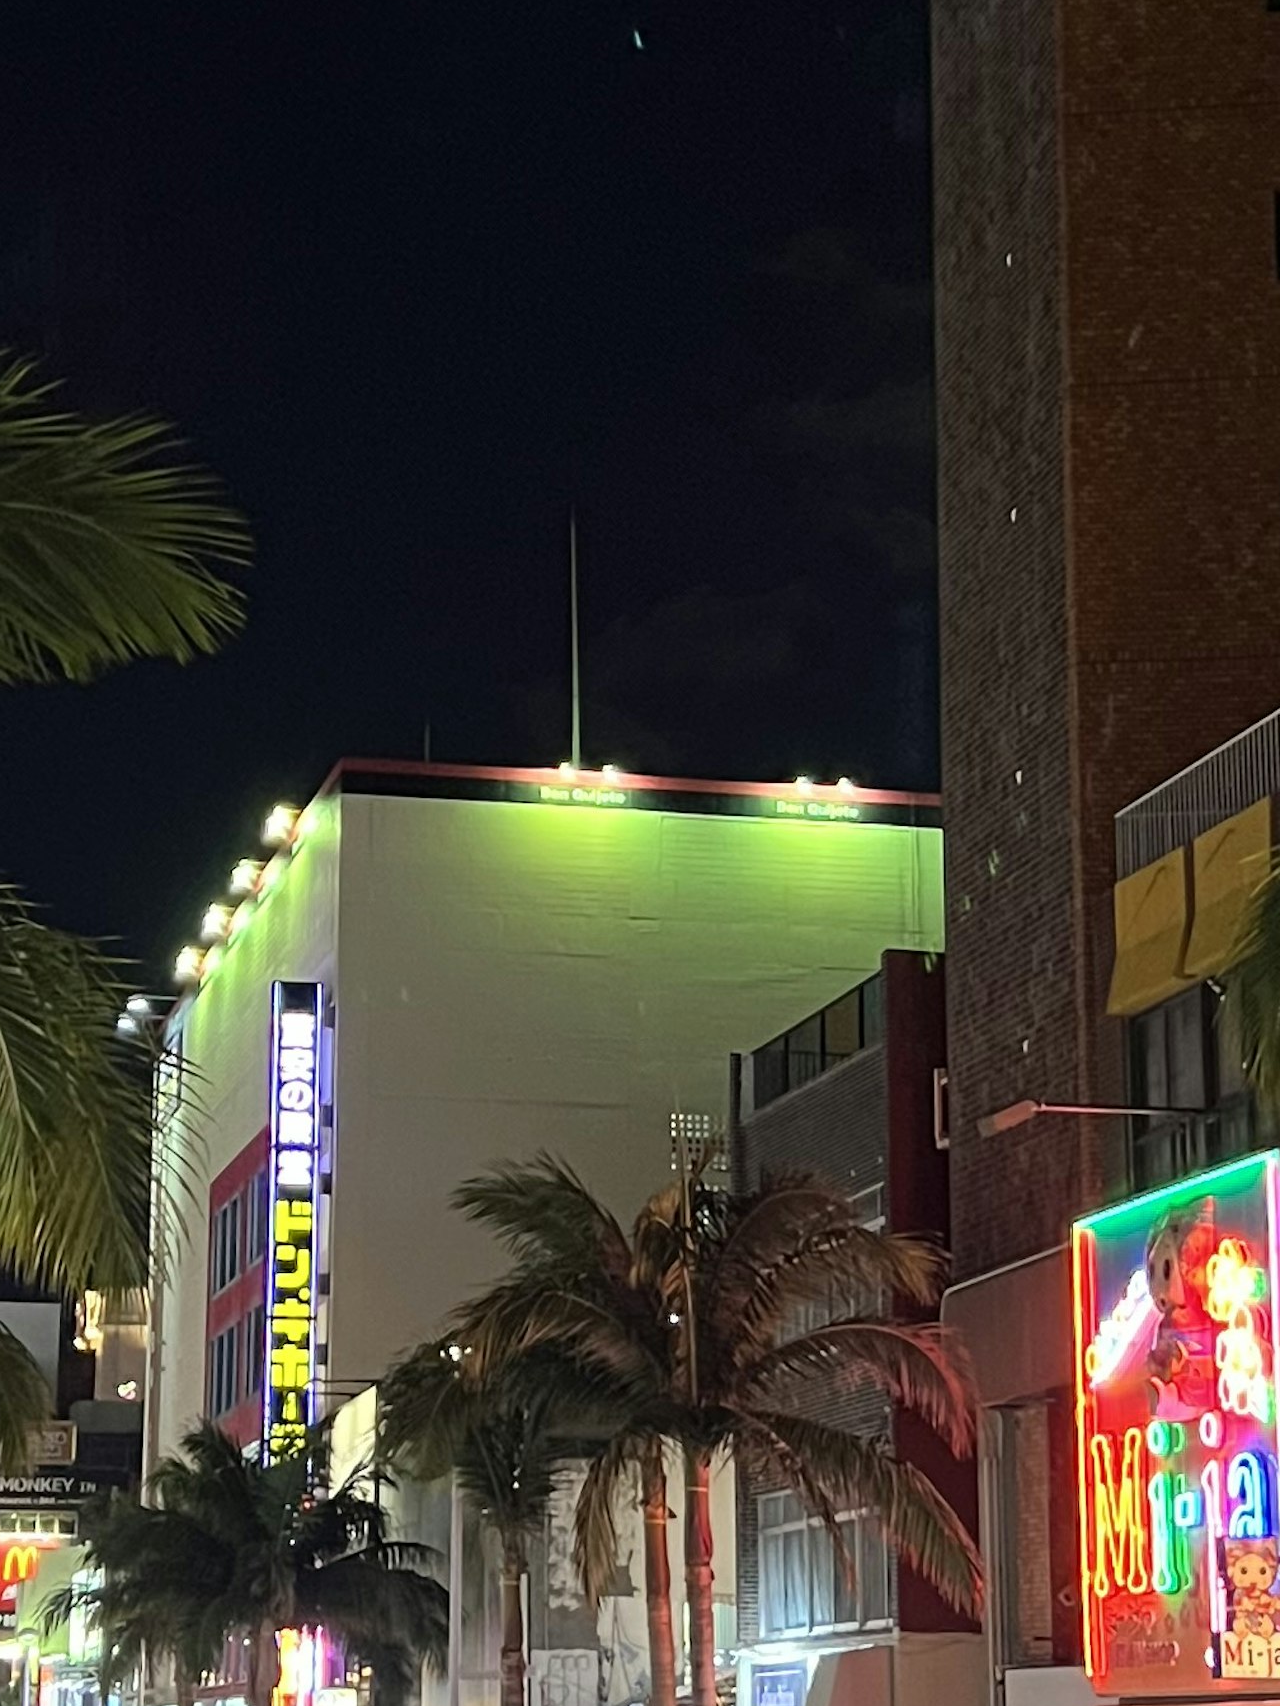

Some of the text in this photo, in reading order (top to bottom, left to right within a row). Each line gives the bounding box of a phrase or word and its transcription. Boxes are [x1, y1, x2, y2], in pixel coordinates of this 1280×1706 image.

[276, 1012, 315, 1185] 安の堂
[0, 1476, 75, 1493] MONKEY
